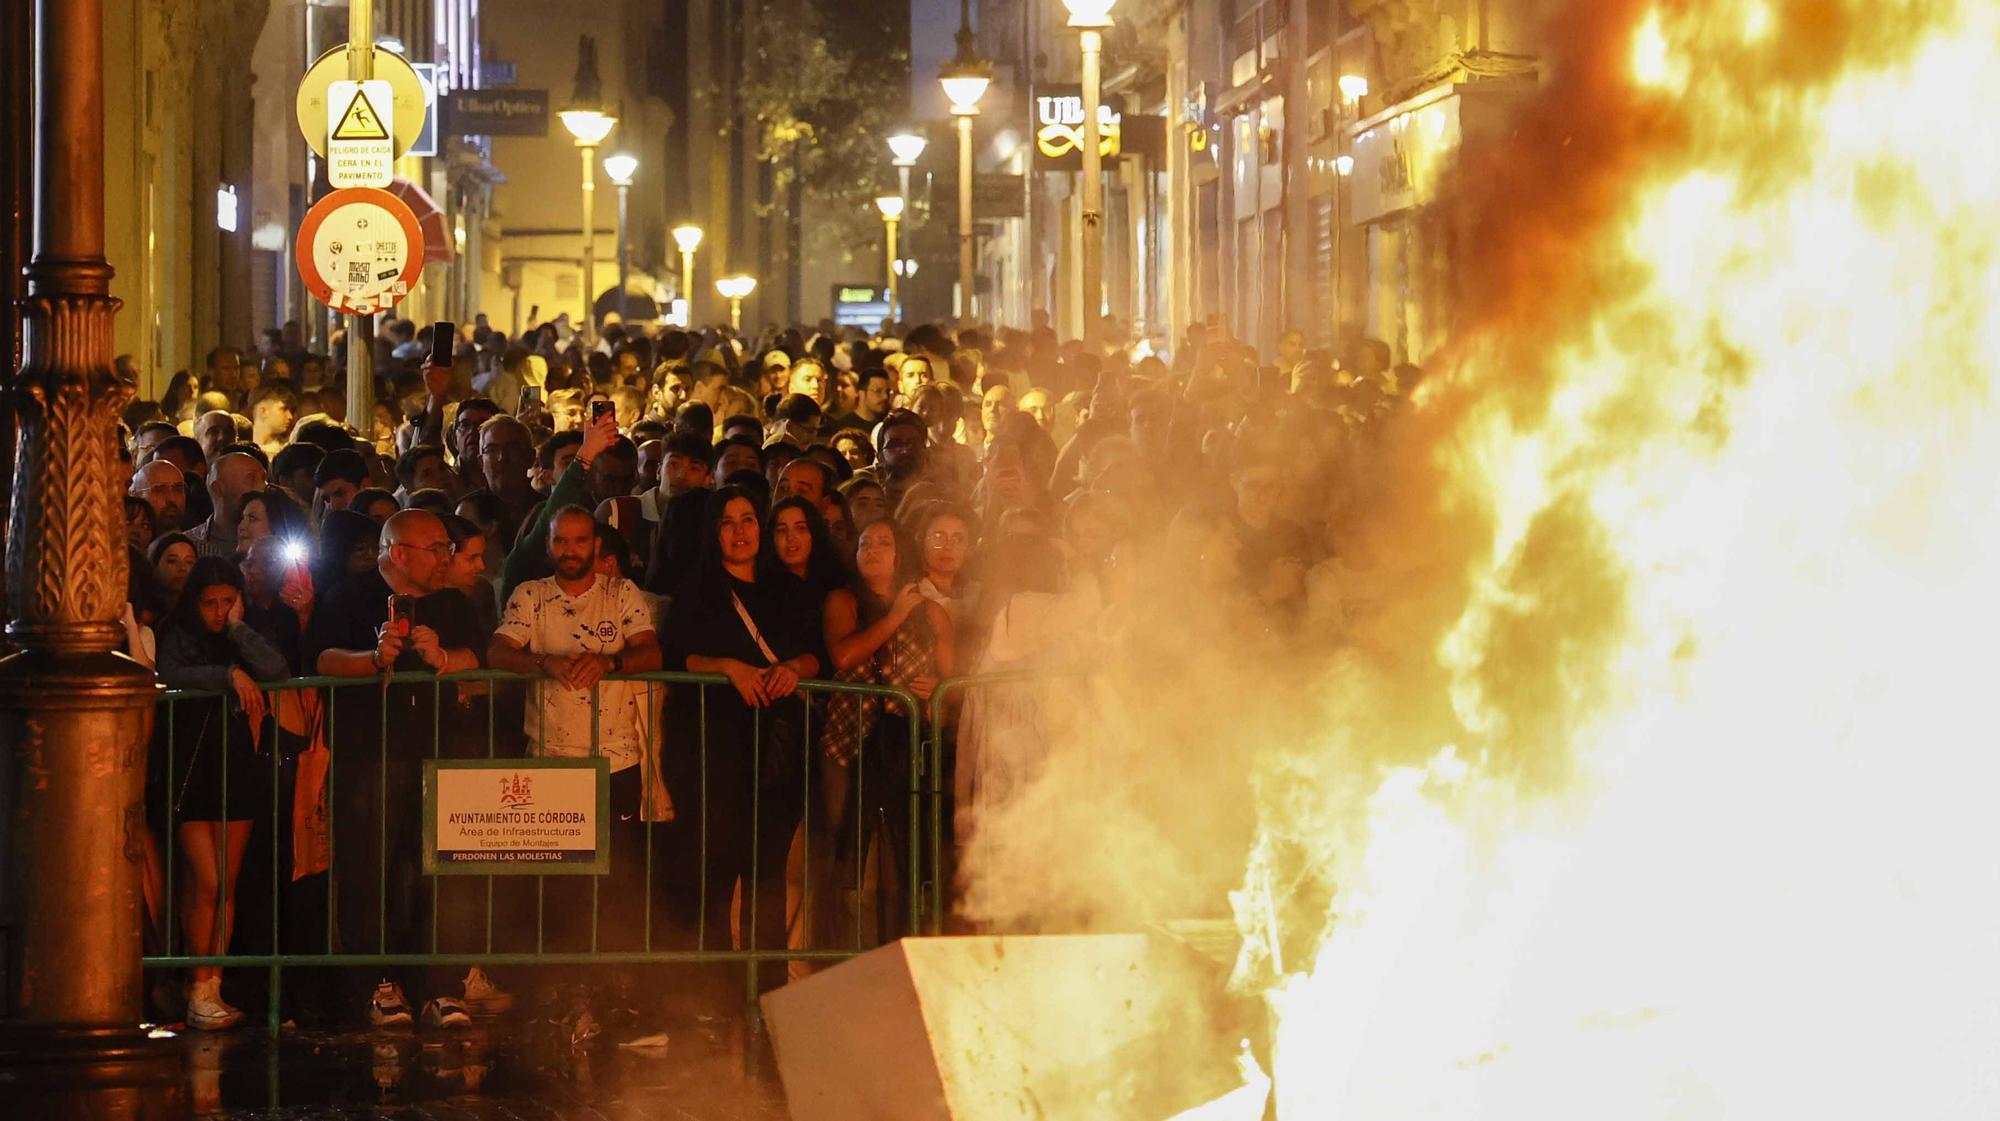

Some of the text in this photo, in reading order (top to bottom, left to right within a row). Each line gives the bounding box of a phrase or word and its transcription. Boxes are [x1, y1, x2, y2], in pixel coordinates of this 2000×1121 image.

[1036, 96, 1121, 124] Ulla
[330, 146, 358, 154] PELIGRO
[360, 146, 369, 154] DE
[360, 159, 371, 167] EN
[374, 159, 383, 167] EL
[449, 809, 586, 824] AYUNTAMIENTO DE CÓRDOBA
[486, 827, 500, 836] de
[502, 827, 582, 836] Infraestructuras
[480, 839, 560, 849] Equipo de Montajes
[453, 852, 562, 860] PERDONEN LAS MOLESTIAS
